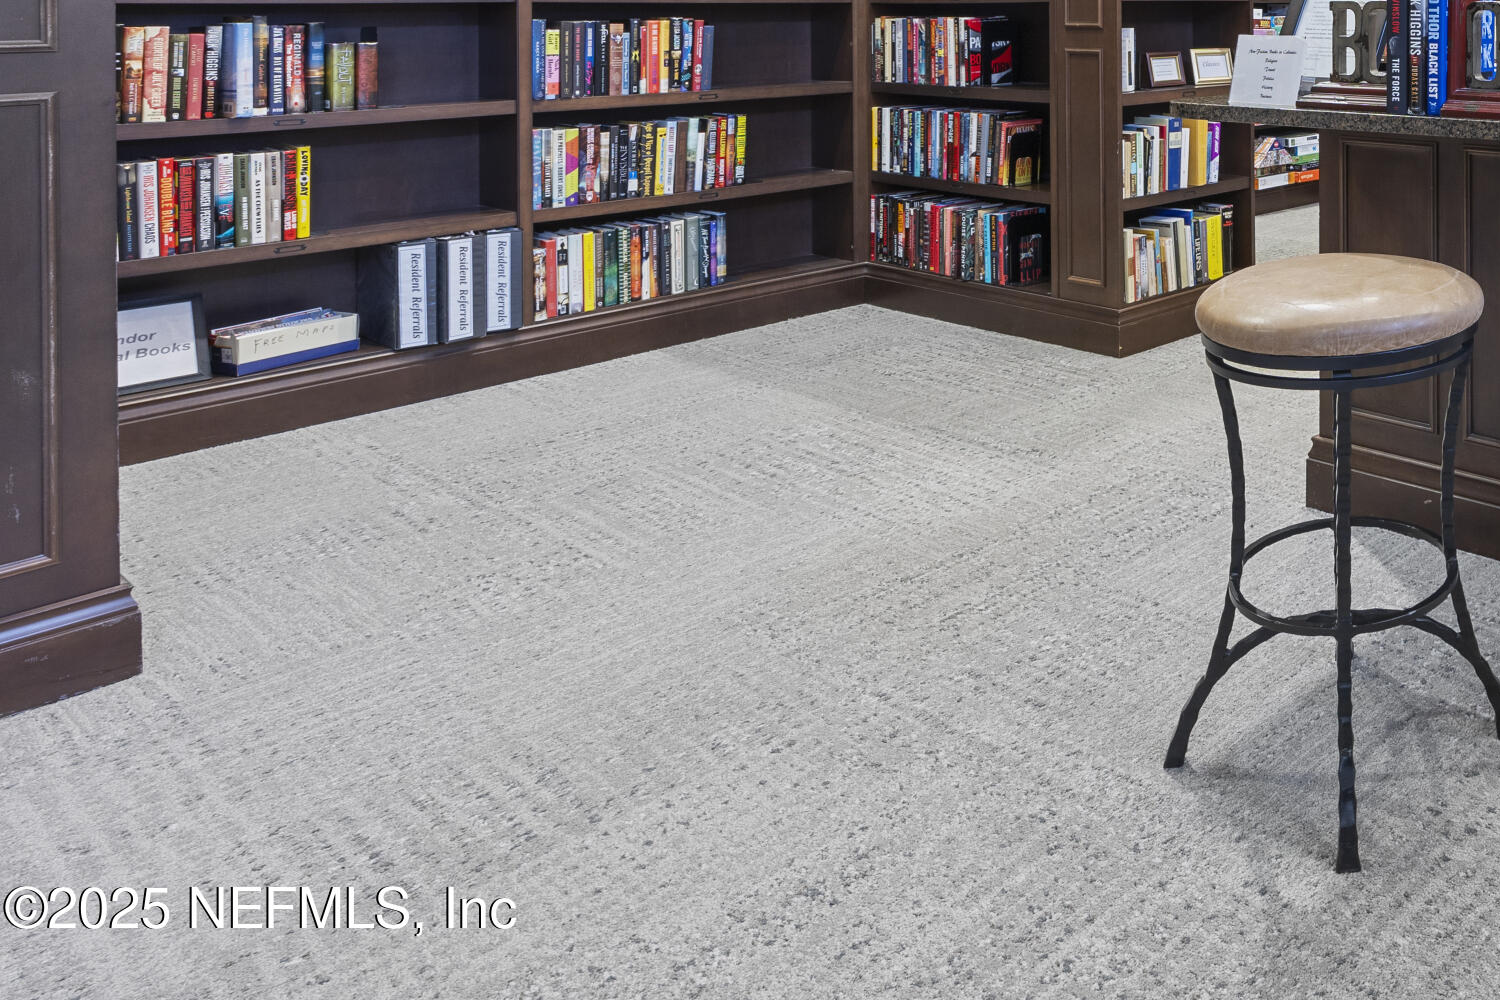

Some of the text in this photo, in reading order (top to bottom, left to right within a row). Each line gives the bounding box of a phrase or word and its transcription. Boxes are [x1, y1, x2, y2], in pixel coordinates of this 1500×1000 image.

[1410, 9, 1422, 57] HIGGINS
[1429, 6, 1440, 40] THOR
[206, 28, 220, 81] JACK HIGGINS
[292, 33, 302, 74] REGINALD
[1391, 58, 1401, 72] THE
[1428, 43, 1439, 75] BLACK
[1391, 73, 1401, 103] FORCE
[1428, 77, 1438, 100] LIST
[300, 150, 309, 197] LOVING DAY
[161, 177, 174, 235] DOUBLE BLIND
[145, 223, 155, 245] CHAOS
[409, 253, 423, 340] Resident Referrals
[457, 246, 469, 331] Resident Referrals
[495, 240, 508, 323] Resident Referrals
[136, 341, 199, 360] Books
[252, 334, 285, 356] FREE
